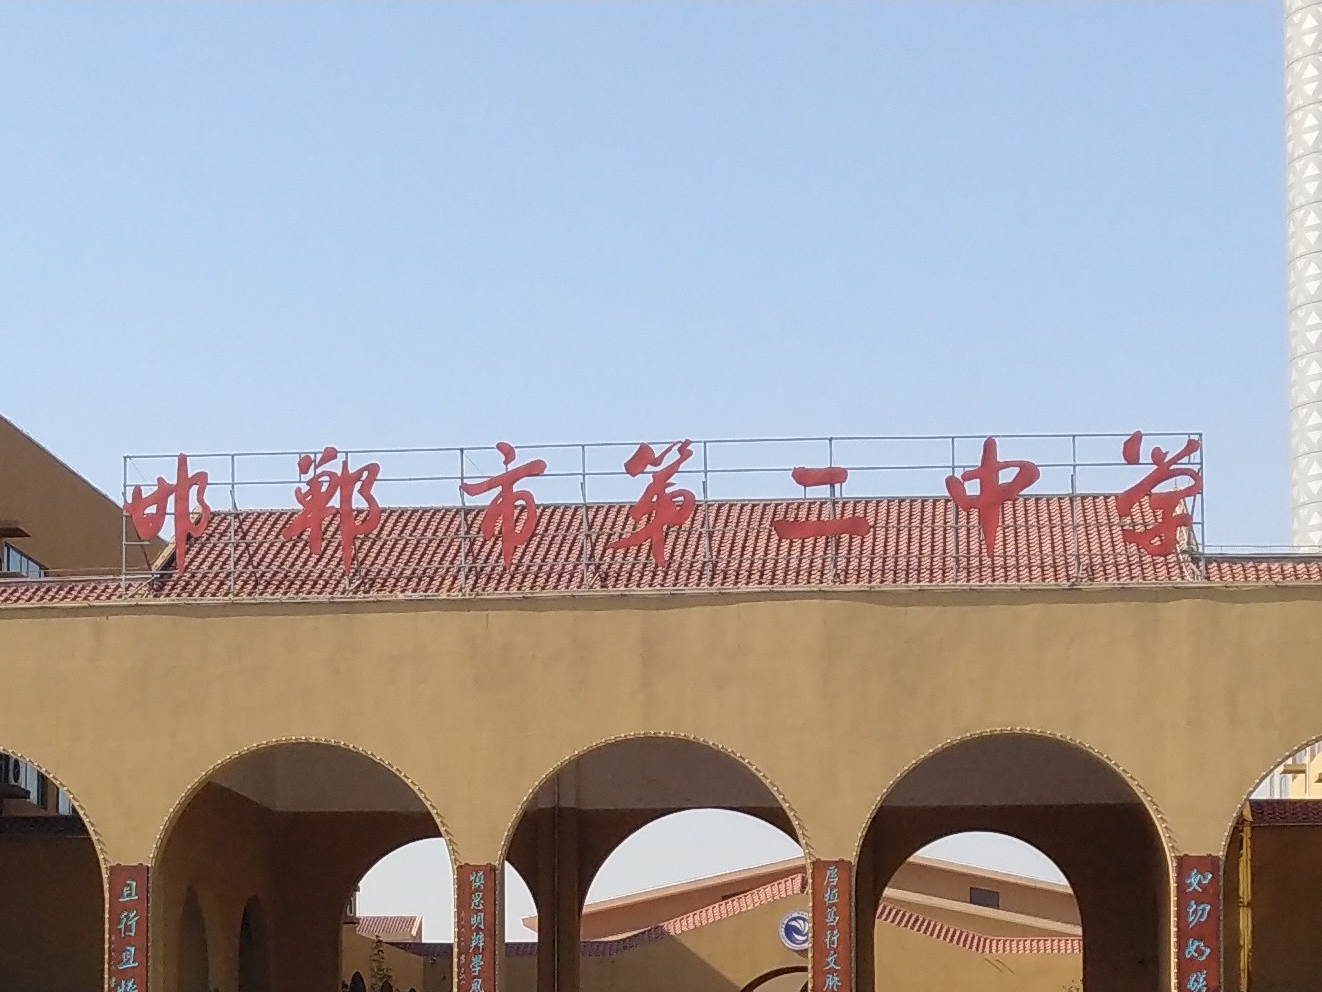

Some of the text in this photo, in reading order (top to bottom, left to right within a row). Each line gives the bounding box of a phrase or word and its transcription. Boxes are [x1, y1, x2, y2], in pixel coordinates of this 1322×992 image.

[124, 430, 1201, 573] 邯郸市第二中学
